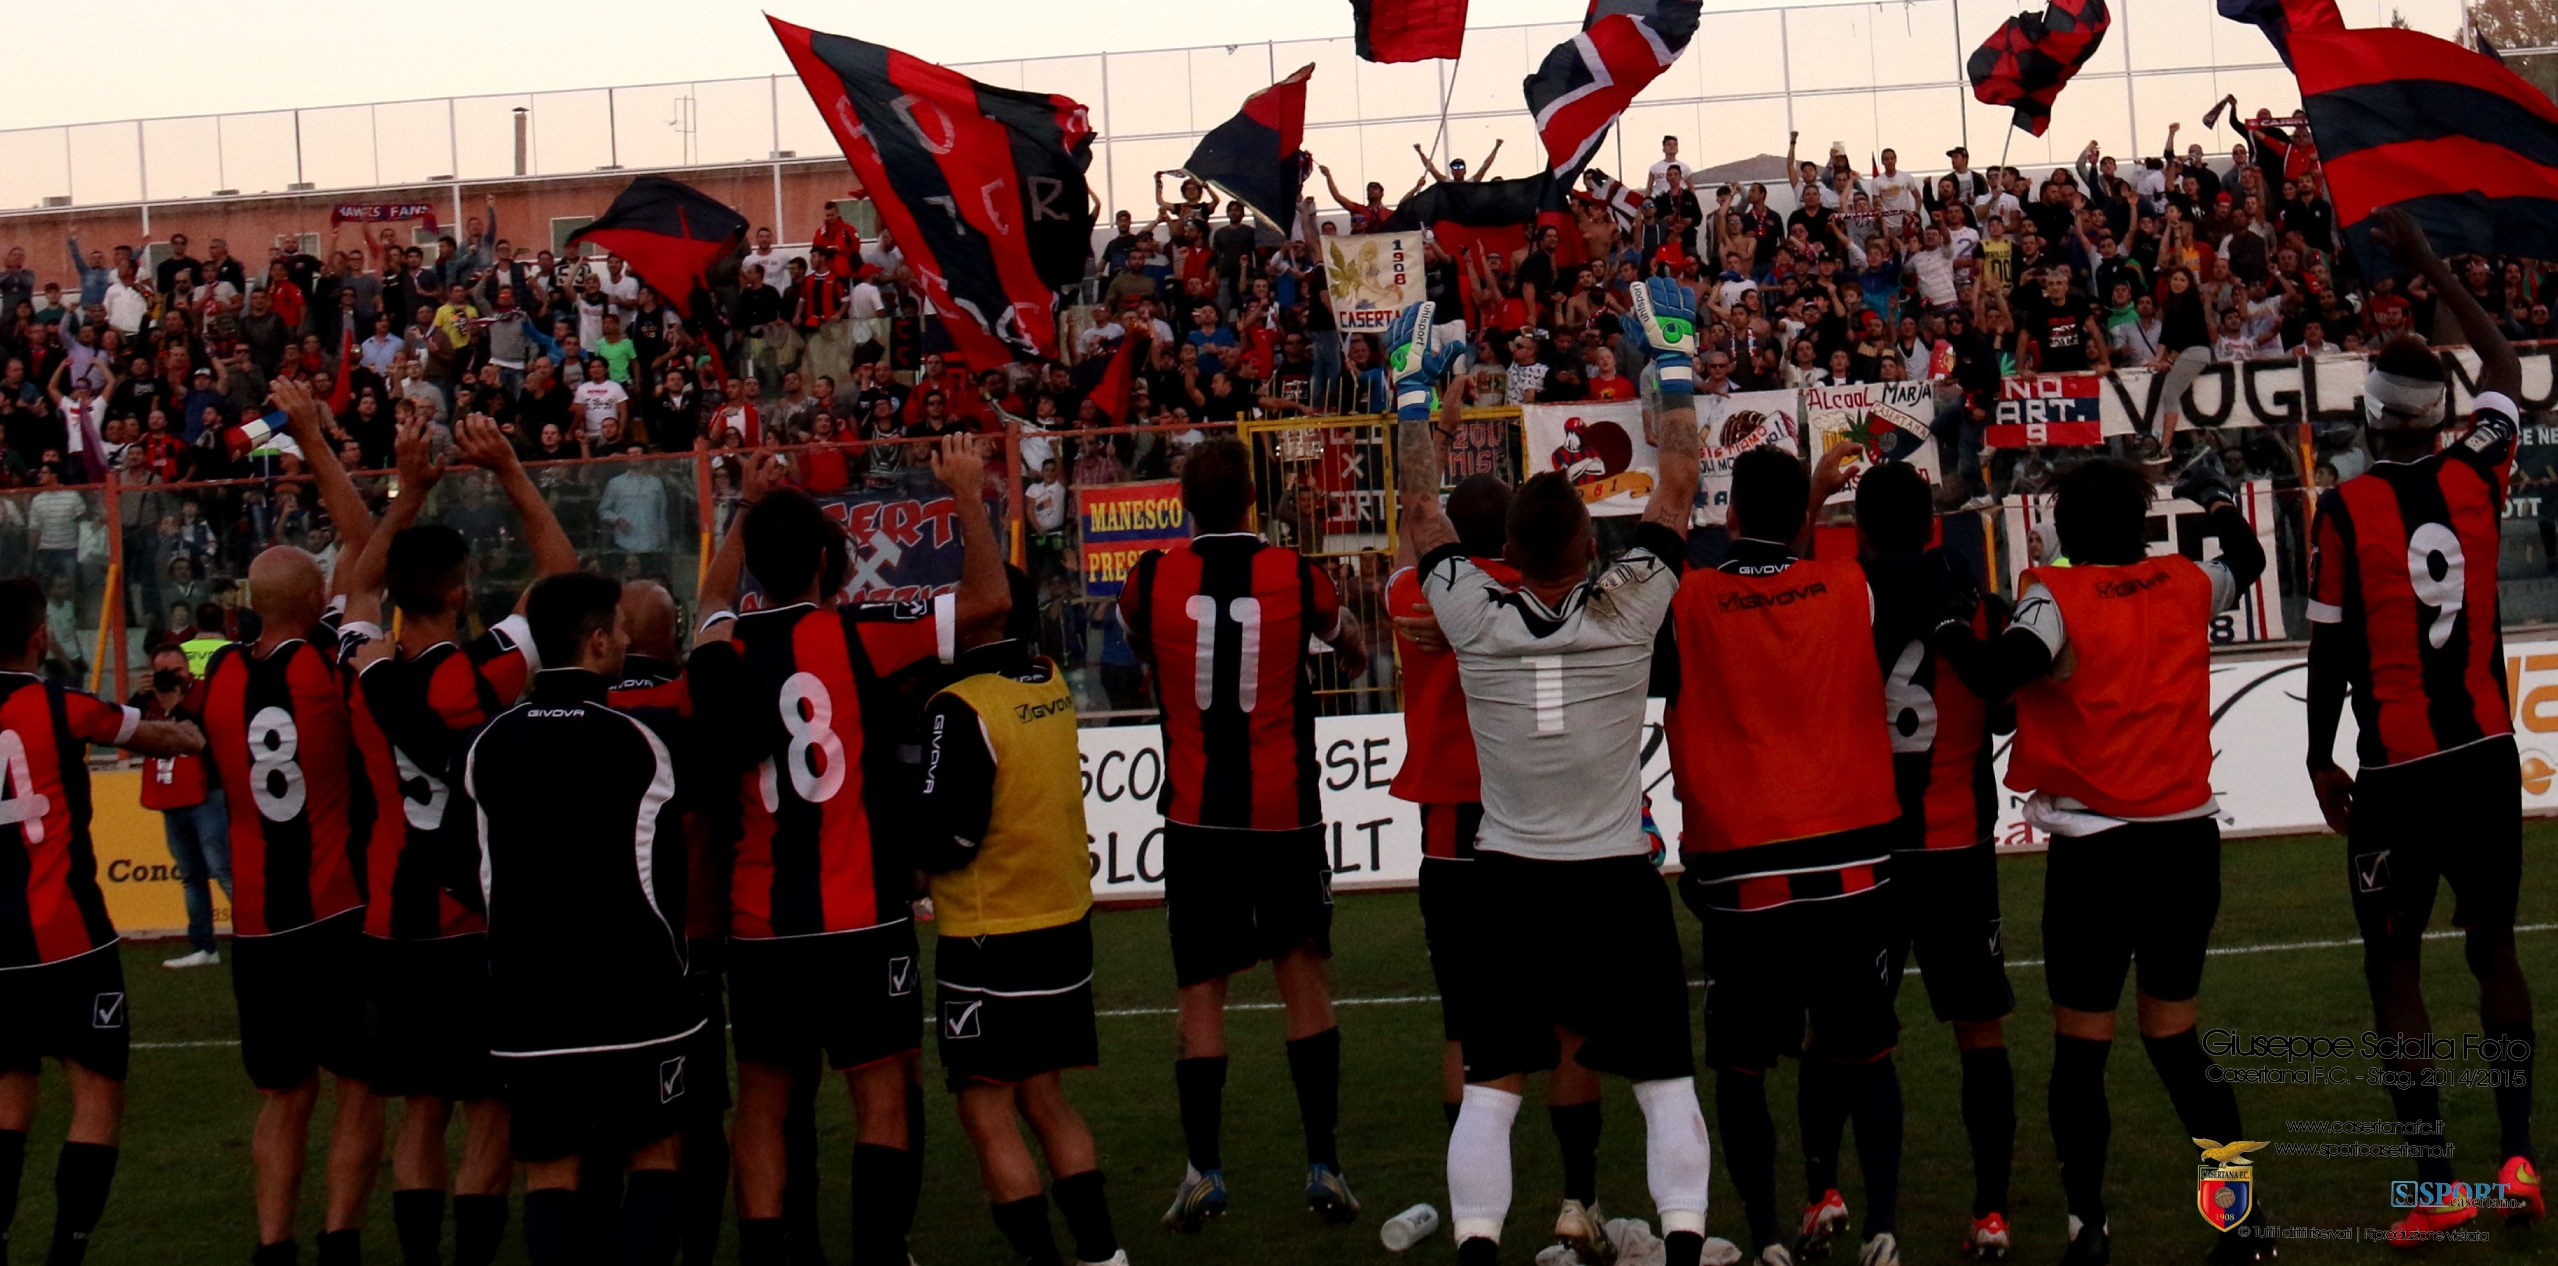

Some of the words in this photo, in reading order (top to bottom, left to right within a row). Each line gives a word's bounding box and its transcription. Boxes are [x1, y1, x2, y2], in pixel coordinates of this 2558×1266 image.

[1808, 387, 1875, 411] ALCOOL
[1996, 398, 2086, 424] ART.
[2004, 376, 2062, 400] NO
[1090, 497, 1184, 533] MANESCO
[1738, 582, 1827, 611] GIVOVA
[2407, 522, 2465, 649] 9
[1185, 594, 1261, 713] 11
[527, 709, 585, 718] GIVOVA
[1521, 655, 1564, 731] 1
[248, 706, 307, 823] 8
[922, 713, 945, 794] GIVOVA
[0, 728, 51, 844] 4
